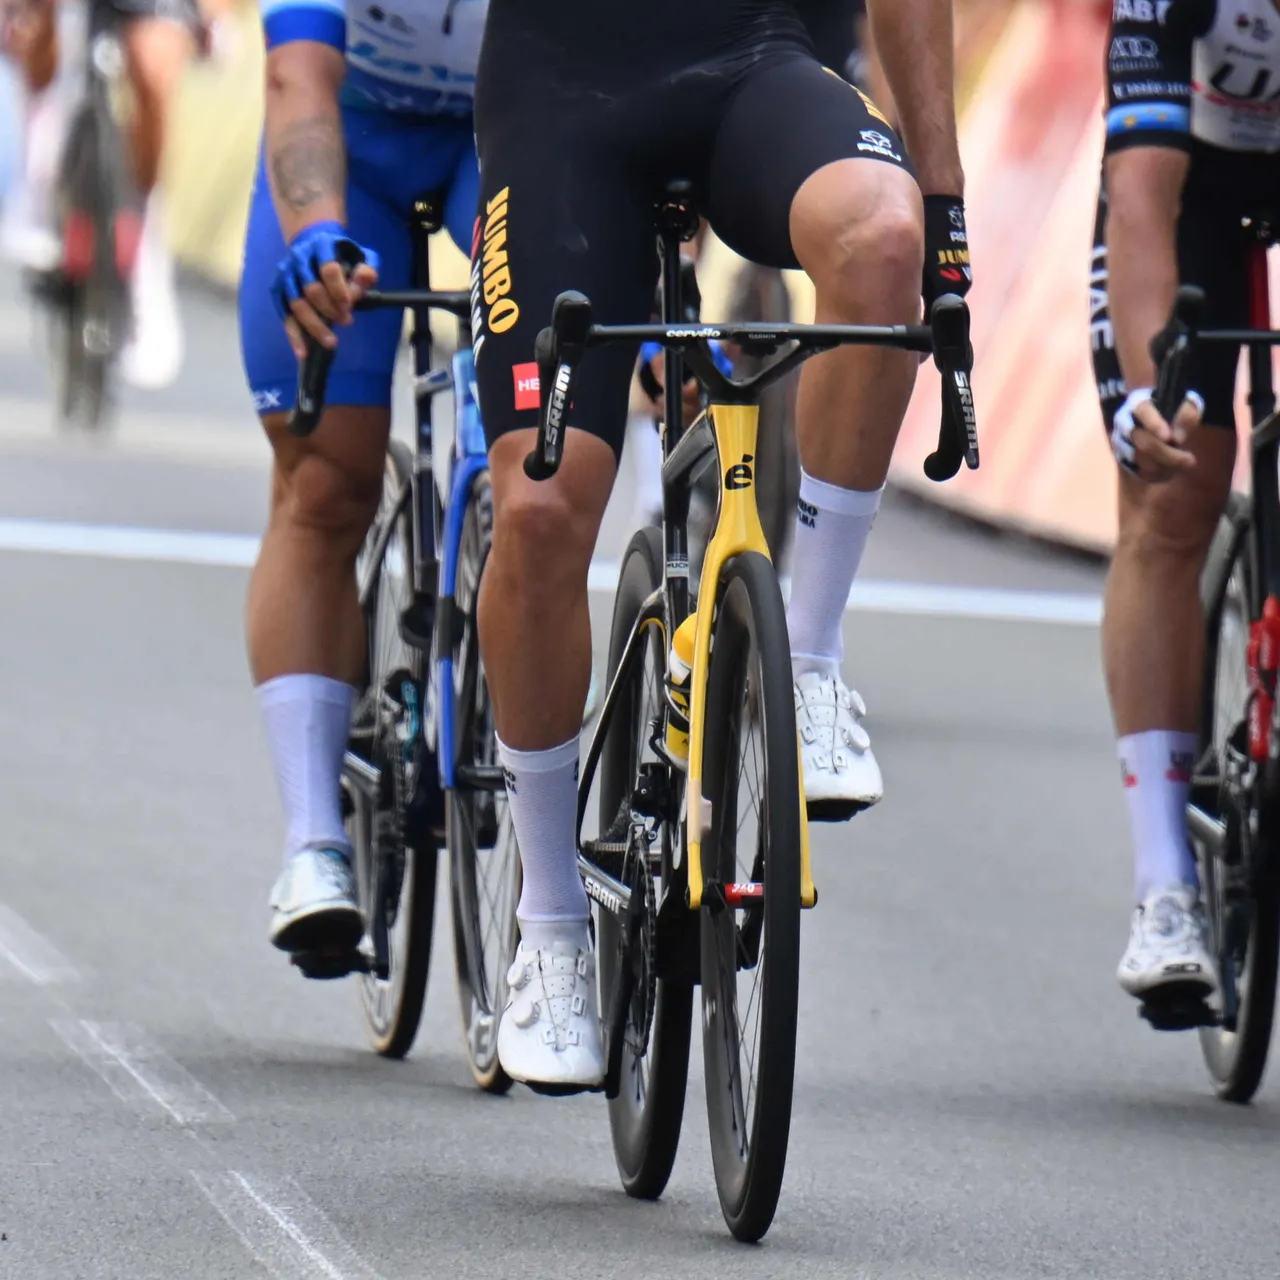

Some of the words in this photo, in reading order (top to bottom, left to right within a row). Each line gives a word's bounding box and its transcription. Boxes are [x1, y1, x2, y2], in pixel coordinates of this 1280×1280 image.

[483, 185, 520, 335] JUMBO
[666, 328, 721, 338] cervélo
[545, 363, 572, 447] SRAM
[953, 370, 977, 450] SRAM
[584, 878, 621, 915] SRAM
